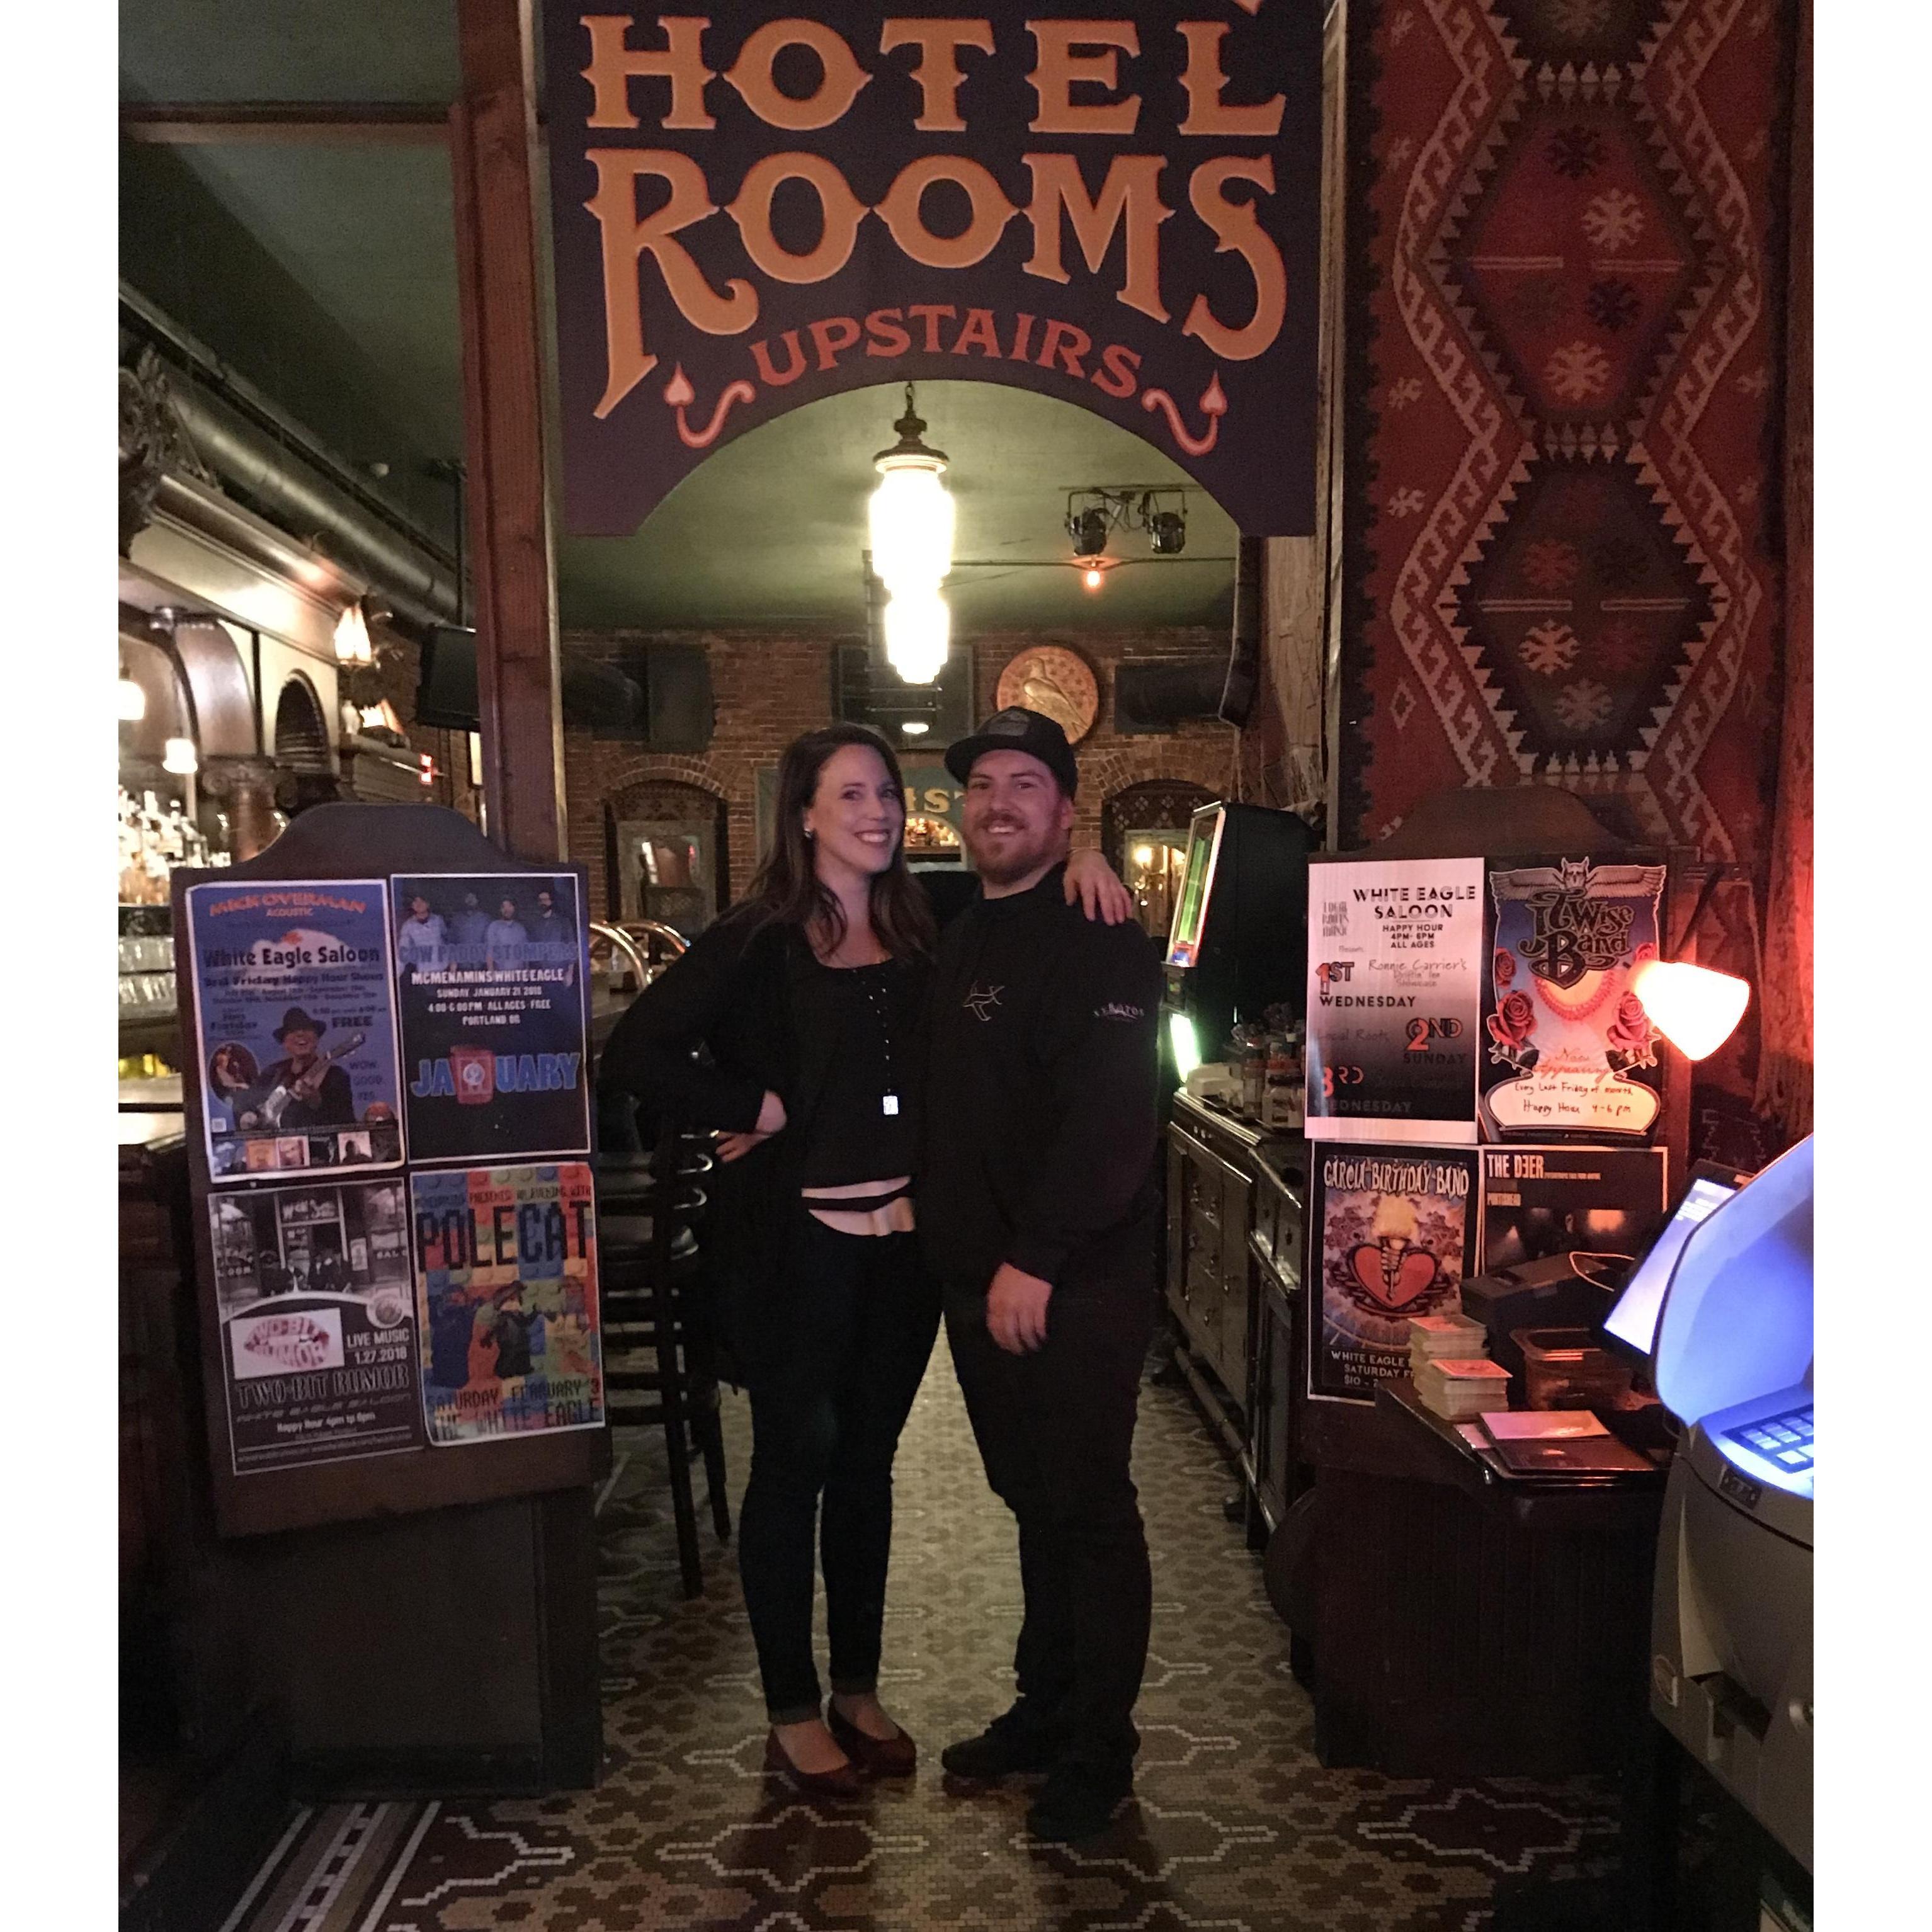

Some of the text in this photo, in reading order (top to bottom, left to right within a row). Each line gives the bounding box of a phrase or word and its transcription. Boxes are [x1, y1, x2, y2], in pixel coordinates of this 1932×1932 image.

[579, 14, 1286, 137] HOTEL
[582, 147, 1287, 420] ROOMS
[749, 304, 1142, 399] UPSTAIRS
[1353, 885, 1475, 902] WHITE EAGLE
[1375, 904, 1453, 919] SALOON
[205, 945, 380, 969] White Eagle Saloon
[1368, 959, 1407, 970] Ronnie
[411, 969, 564, 985] MCMENAMINS WHITE EAGLE
[1315, 962, 1355, 995] 1ST
[437, 988, 469, 998] SUNDAY
[473, 987, 511, 997] JANUARY
[487, 1001, 502, 1011] ALL
[504, 1000, 526, 1010] AGES
[530, 999, 551, 1009] FREE
[1319, 996, 1416, 1008] WEDNESDAY
[332, 1016, 373, 1028] FREE
[1406, 1017, 1463, 1051] 2ND
[1404, 1052, 1467, 1064] SUNDAY
[1322, 1066, 1364, 1098] 3RD
[1562, 1082, 1588, 1097] Friday
[1523, 1099, 1552, 1117] Happy
[1487, 1154, 1510, 1178] THE
[1324, 1159, 1469, 1196] GARCIA BIRTHDAY BAND
[416, 1201, 591, 1273] POLECAT
[347, 1328, 410, 1348] LIVE MUSIC
[1331, 1350, 1366, 1364] WHITE
[1370, 1355, 1405, 1367] EAGLE
[1344, 1363, 1400, 1378] SATURDAY
[427, 1388, 499, 1412] SATURDAY
